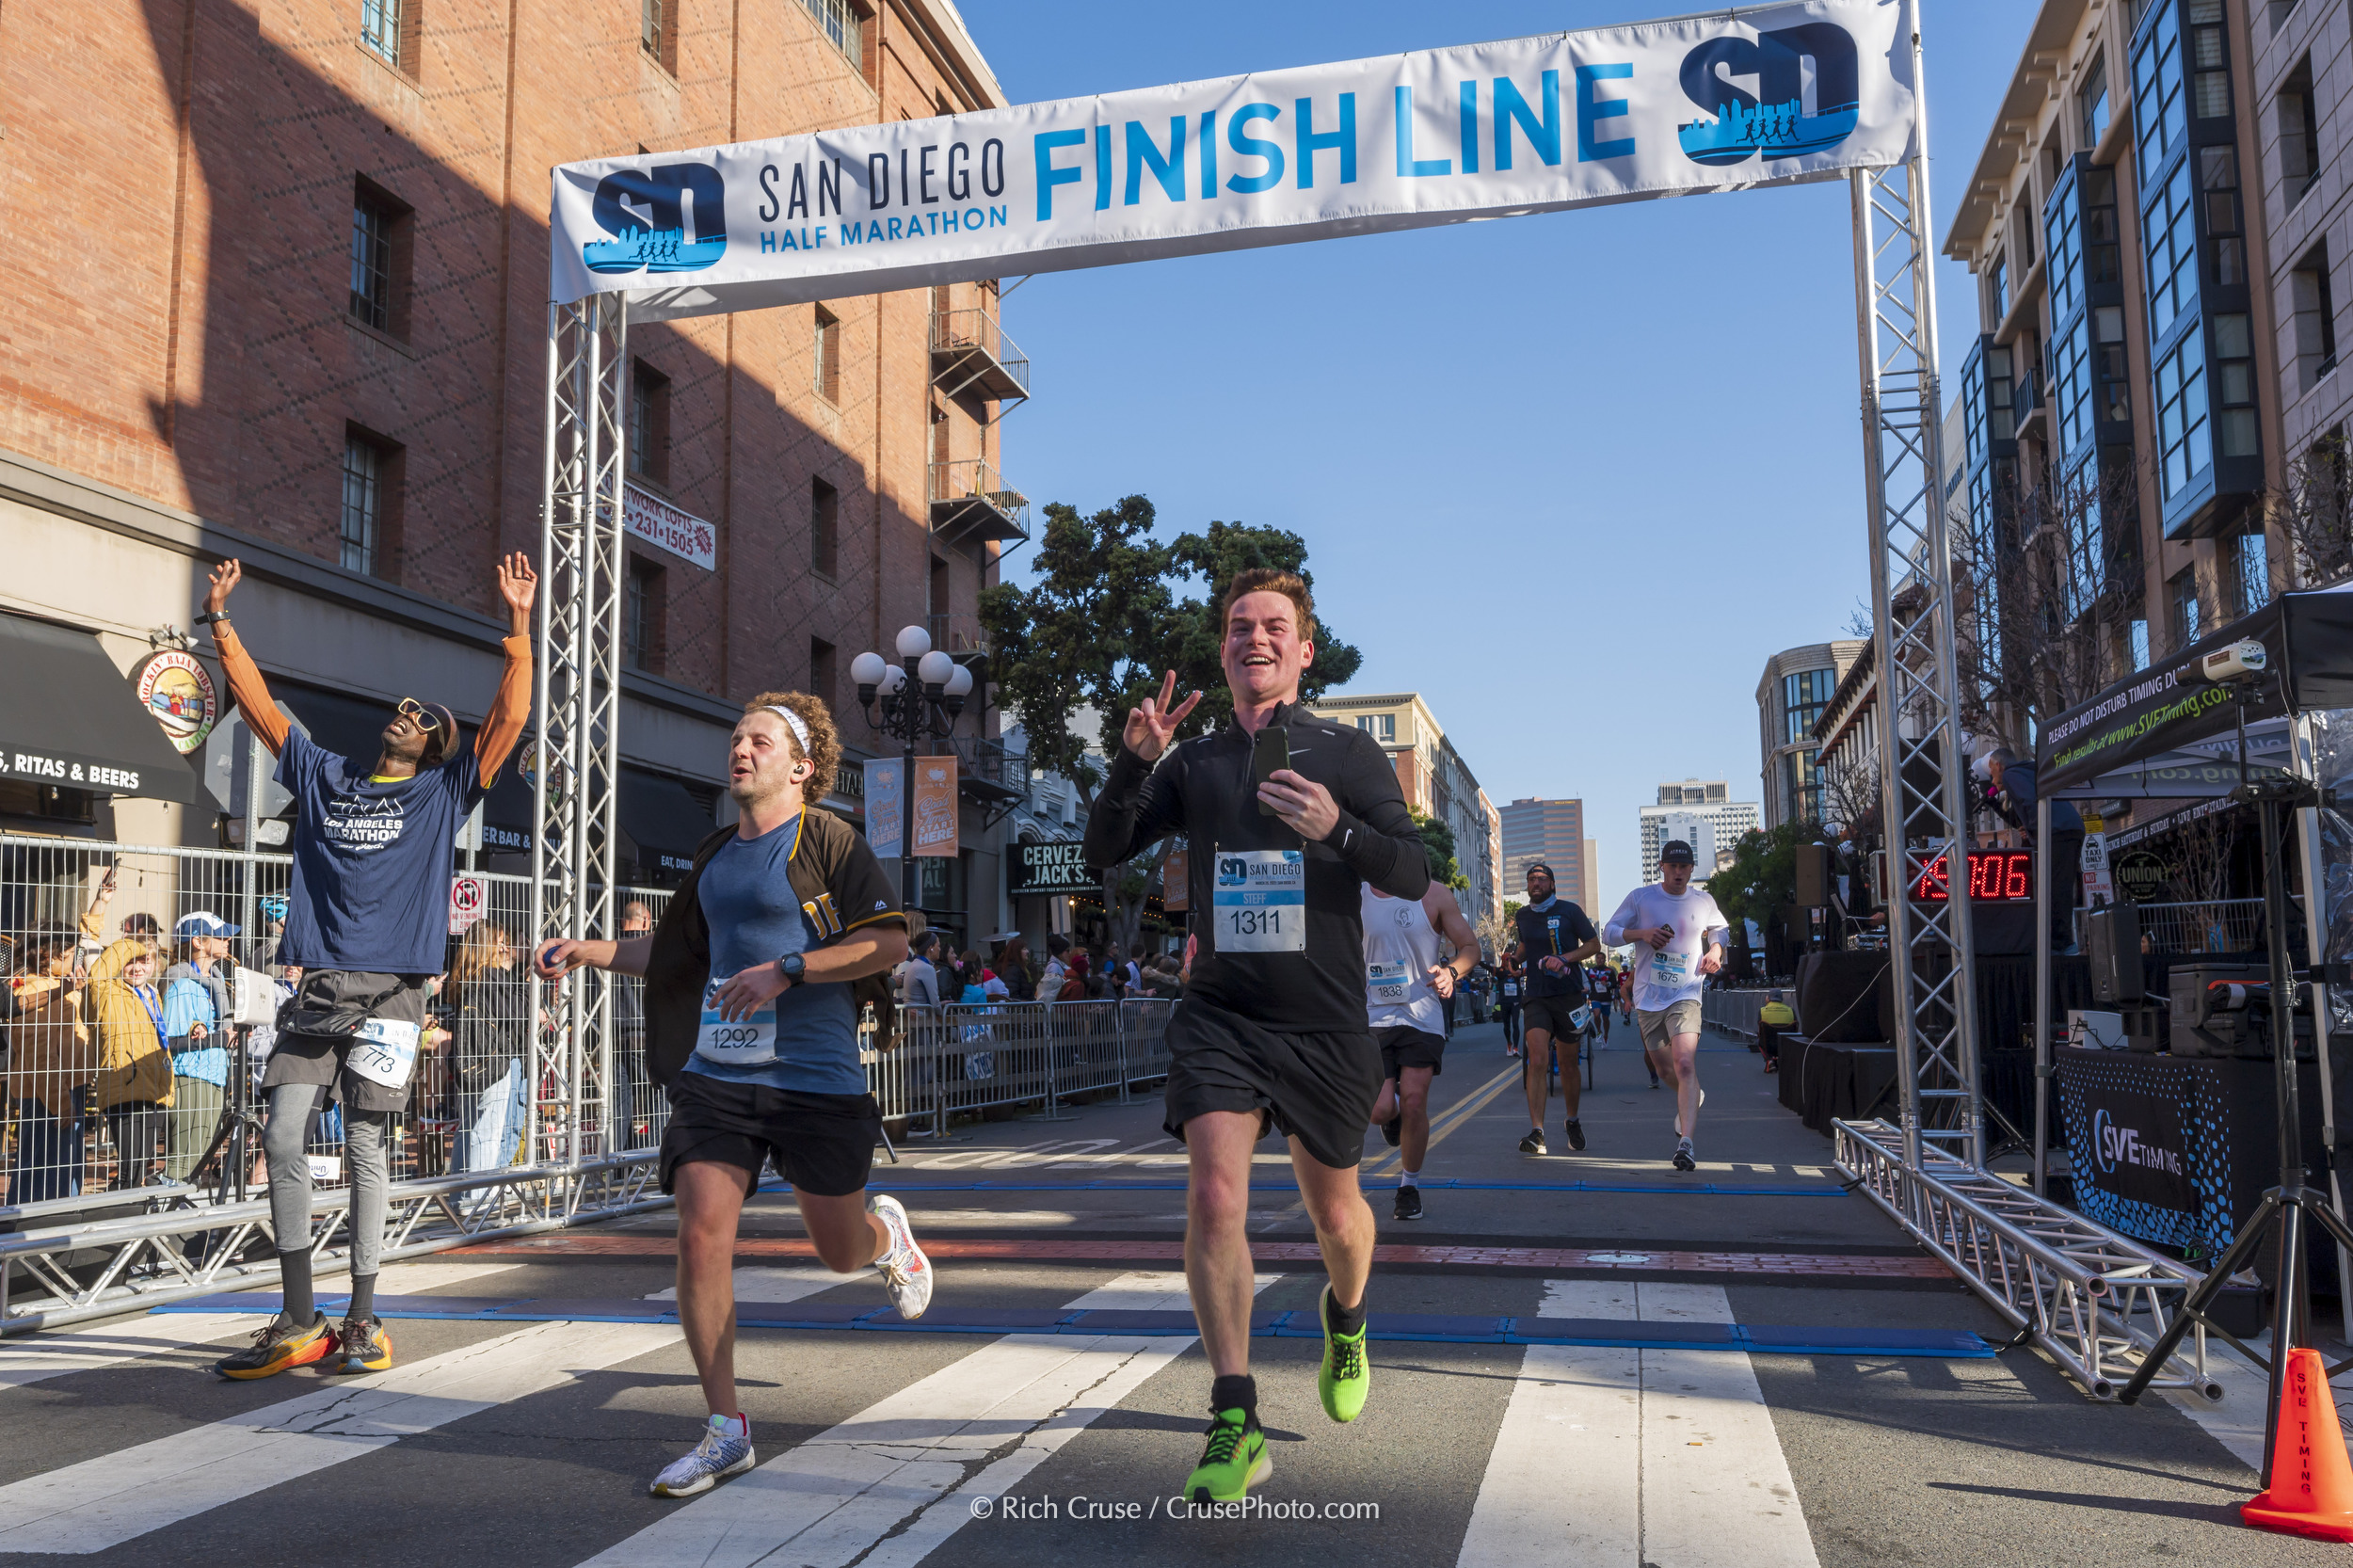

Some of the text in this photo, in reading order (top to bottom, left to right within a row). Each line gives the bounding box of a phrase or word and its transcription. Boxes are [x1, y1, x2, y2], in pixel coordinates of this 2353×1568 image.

[1034, 62, 1636, 222] FINISH LINE
[759, 137, 1005, 224] SAN DIEGO
[760, 204, 1007, 254] HALF MARATHON
[664, 508, 693, 538] LOFTS
[167, 654, 191, 668] BAJA
[193, 664, 215, 717] LOBSTER
[2048, 727, 2069, 745] PLEASE
[2069, 717, 2080, 734] DO
[2079, 709, 2095, 728] NOT
[2095, 692, 2128, 723] DISTURB
[2128, 675, 2163, 705] TIMING
[178, 722, 212, 750] CANTINA
[2054, 750, 2072, 770] Find
[2072, 738, 2098, 761] results
[2097, 731, 2109, 750] at
[15, 753, 66, 778] RITAS
[70, 762, 85, 781] &
[88, 764, 139, 790] BEERS
[344, 819, 404, 829] ANGELES
[2150, 817, 2169, 835] SUNDAY
[2177, 809, 2191, 824] LIVE
[324, 826, 401, 841] MARATHON
[872, 821, 901, 836] START
[918, 827, 954, 845] HERE
[920, 819, 954, 834] START
[499, 829, 520, 847] BAR
[523, 834, 531, 848] &
[872, 828, 901, 847] HERE
[661, 855, 694, 870] EAT, DRIN
[1023, 844, 1086, 866] CERVEZ
[1250, 864, 1268, 875] SAN
[1273, 863, 1301, 875] DIEGO
[2085, 873, 2095, 882] NO
[2122, 866, 2162, 883] UNION
[2087, 883, 2110, 891] PARKING
[1243, 893, 1266, 904] STEFF
[1230, 909, 1280, 935] 1311
[1657, 971, 1679, 983] 1675
[1378, 985, 1403, 998] 1838
[711, 1028, 759, 1048] 1292
[362, 1046, 395, 1073] 773
[2297, 1373, 2311, 1494] SVE TIMING
